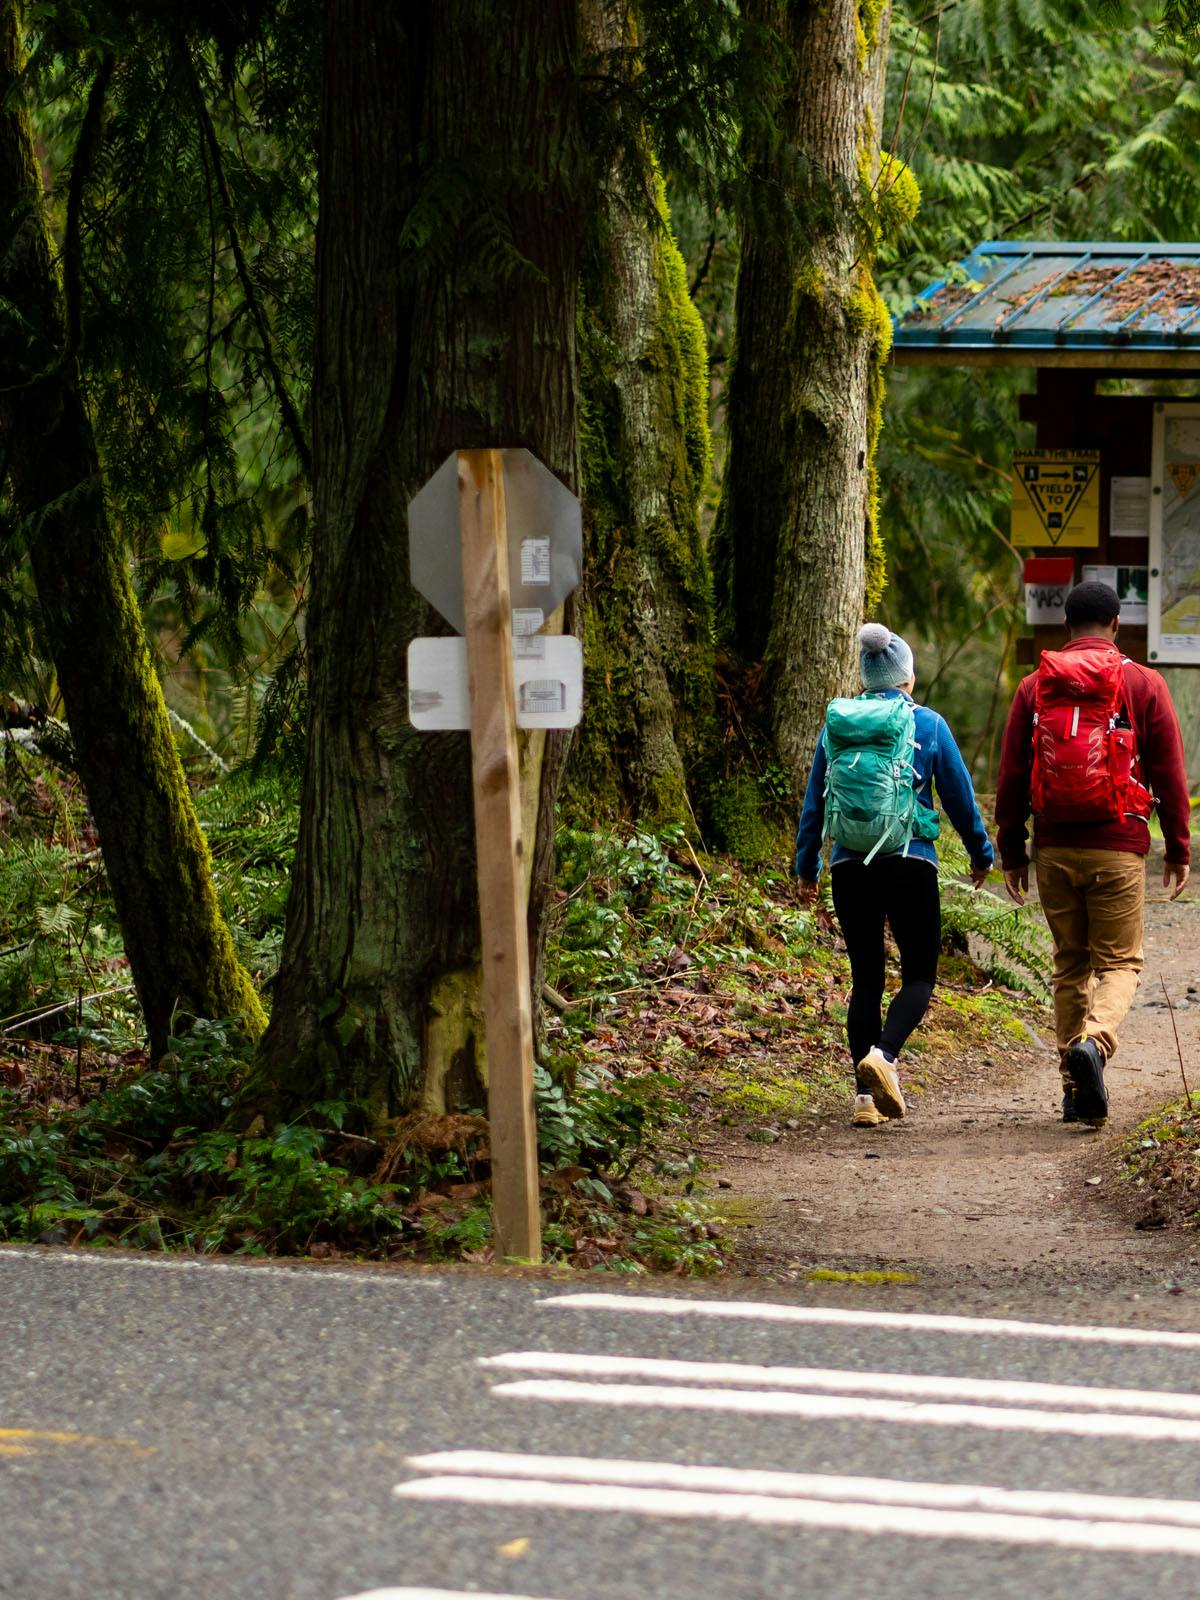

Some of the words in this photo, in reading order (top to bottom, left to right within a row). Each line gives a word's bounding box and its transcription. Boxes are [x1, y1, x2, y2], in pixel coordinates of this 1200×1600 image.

[1013, 449, 1044, 458] SHARE
[1049, 449, 1068, 458] THE
[1071, 449, 1099, 458] TRAIL
[1039, 484, 1073, 494] YIELD
[1047, 495, 1064, 504] TO
[1029, 587, 1064, 608] MAPS
